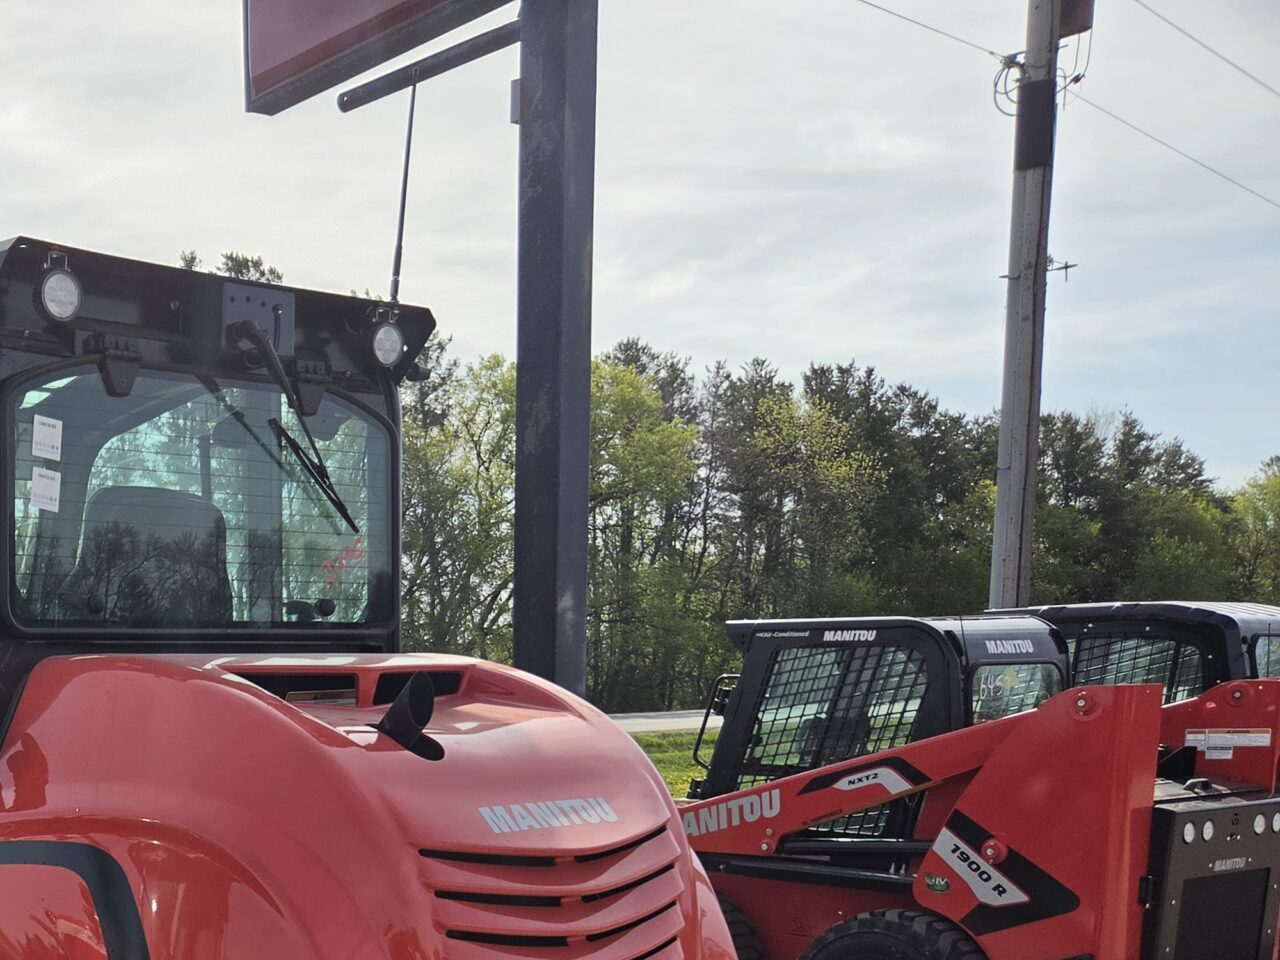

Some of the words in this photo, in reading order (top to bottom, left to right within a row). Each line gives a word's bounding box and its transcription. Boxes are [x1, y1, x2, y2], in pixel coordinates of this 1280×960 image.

[823, 630, 877, 642] MANITOU
[985, 639, 1034, 654] MANITOU
[847, 772, 879, 786] NXT2
[478, 797, 618, 834] MANITOU
[682, 789, 781, 838] ANITOU
[1213, 857, 1247, 872] MANITOU
[991, 883, 1007, 898] R
